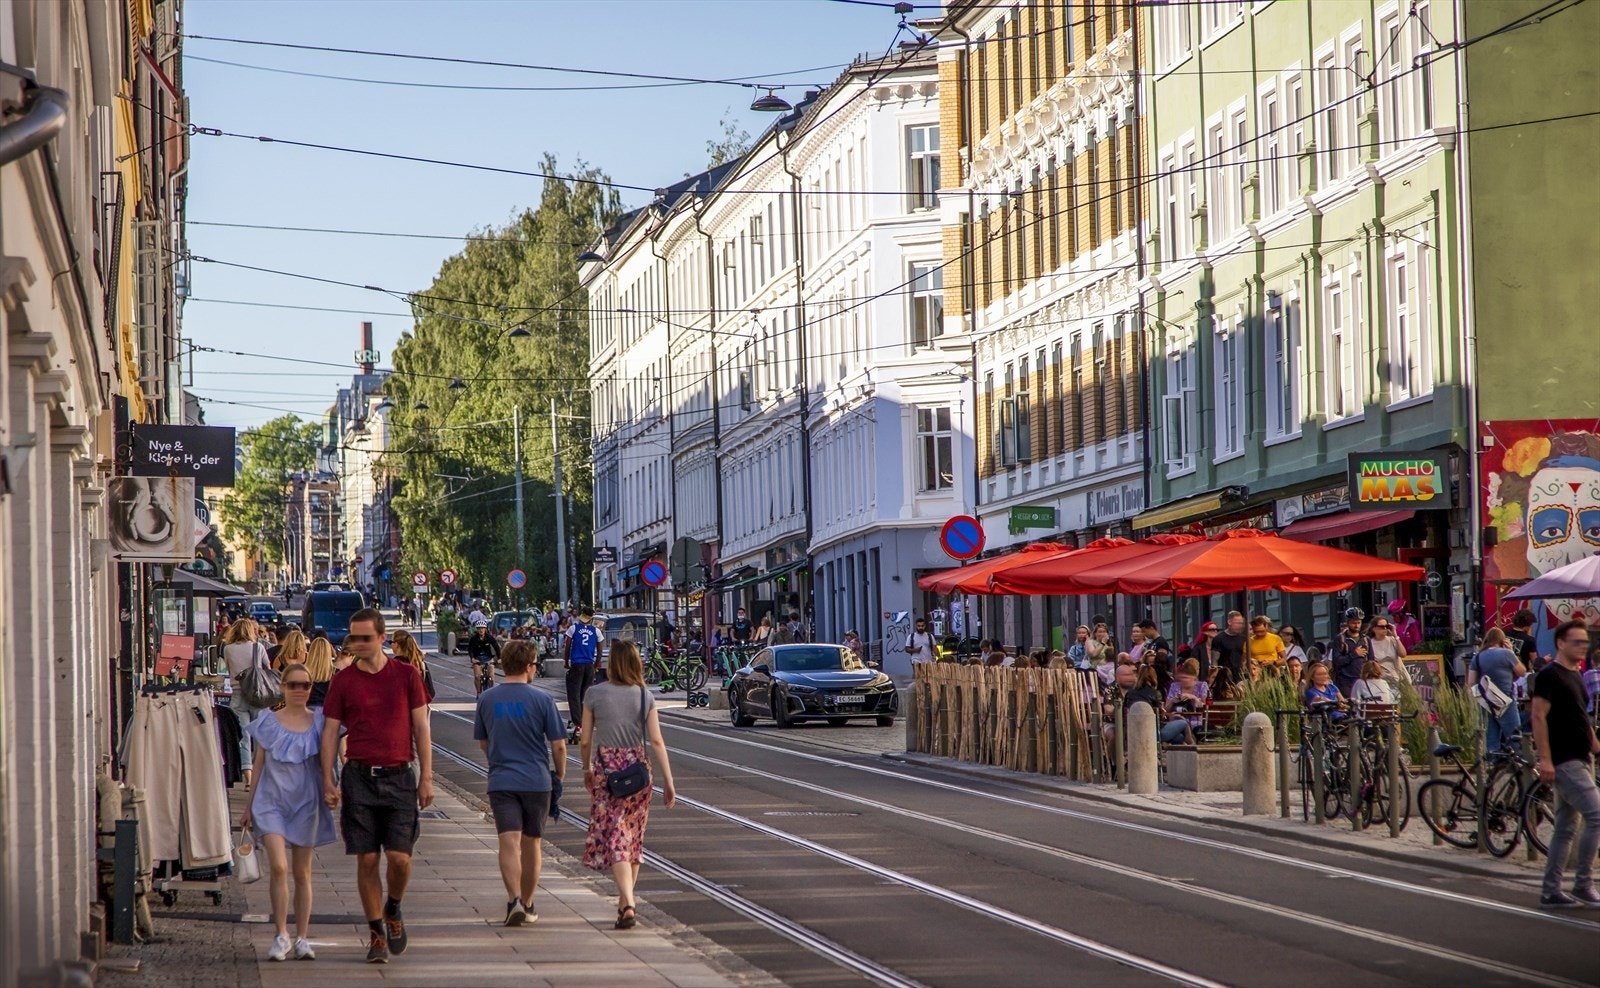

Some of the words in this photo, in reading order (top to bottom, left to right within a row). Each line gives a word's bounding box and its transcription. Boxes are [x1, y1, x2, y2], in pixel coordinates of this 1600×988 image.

[149, 440, 172, 452] Nye
[174, 441, 184, 451] &
[1361, 460, 1434, 476] MUCHO
[1360, 477, 1435, 502] MAS
[582, 634, 589, 646] 2
[1405, 664, 1421, 675] Try
